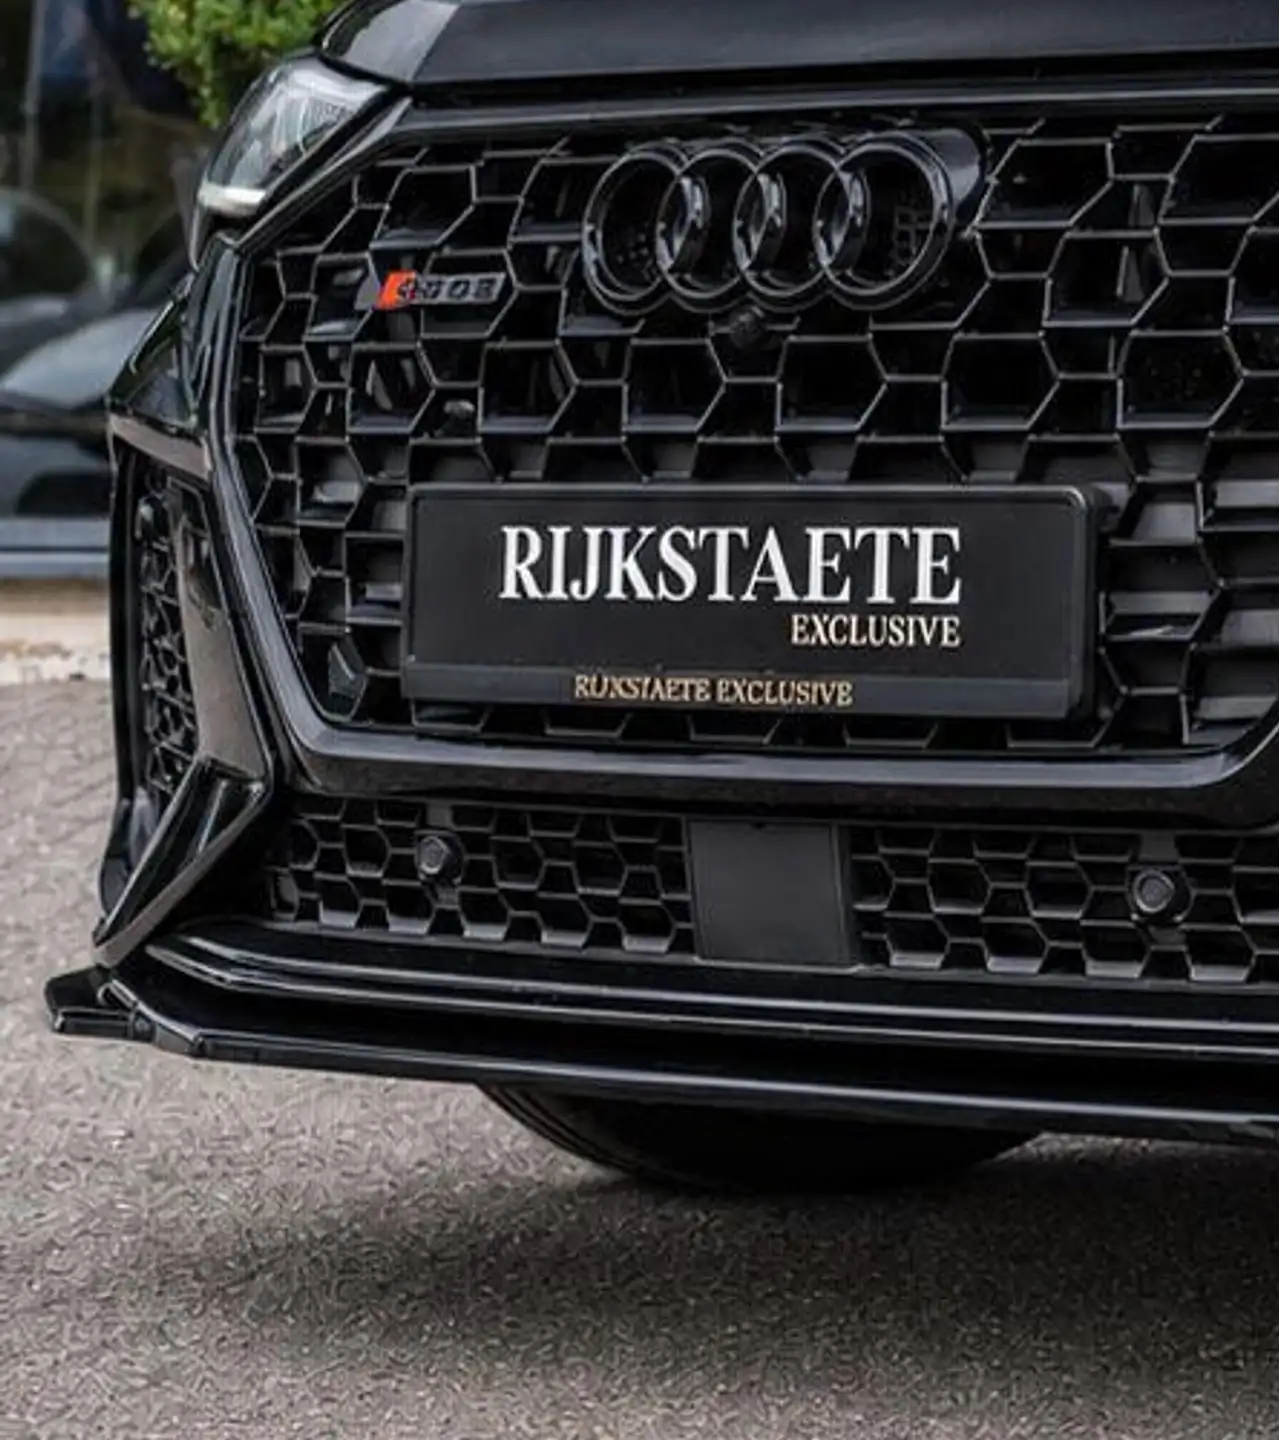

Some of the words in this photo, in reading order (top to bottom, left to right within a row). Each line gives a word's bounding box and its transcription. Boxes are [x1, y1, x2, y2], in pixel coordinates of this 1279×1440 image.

[498, 524, 961, 606] RIJKSTAETE
[790, 612, 961, 648] EXCLUSIVE
[716, 677, 853, 707] EXCLUSIVE
